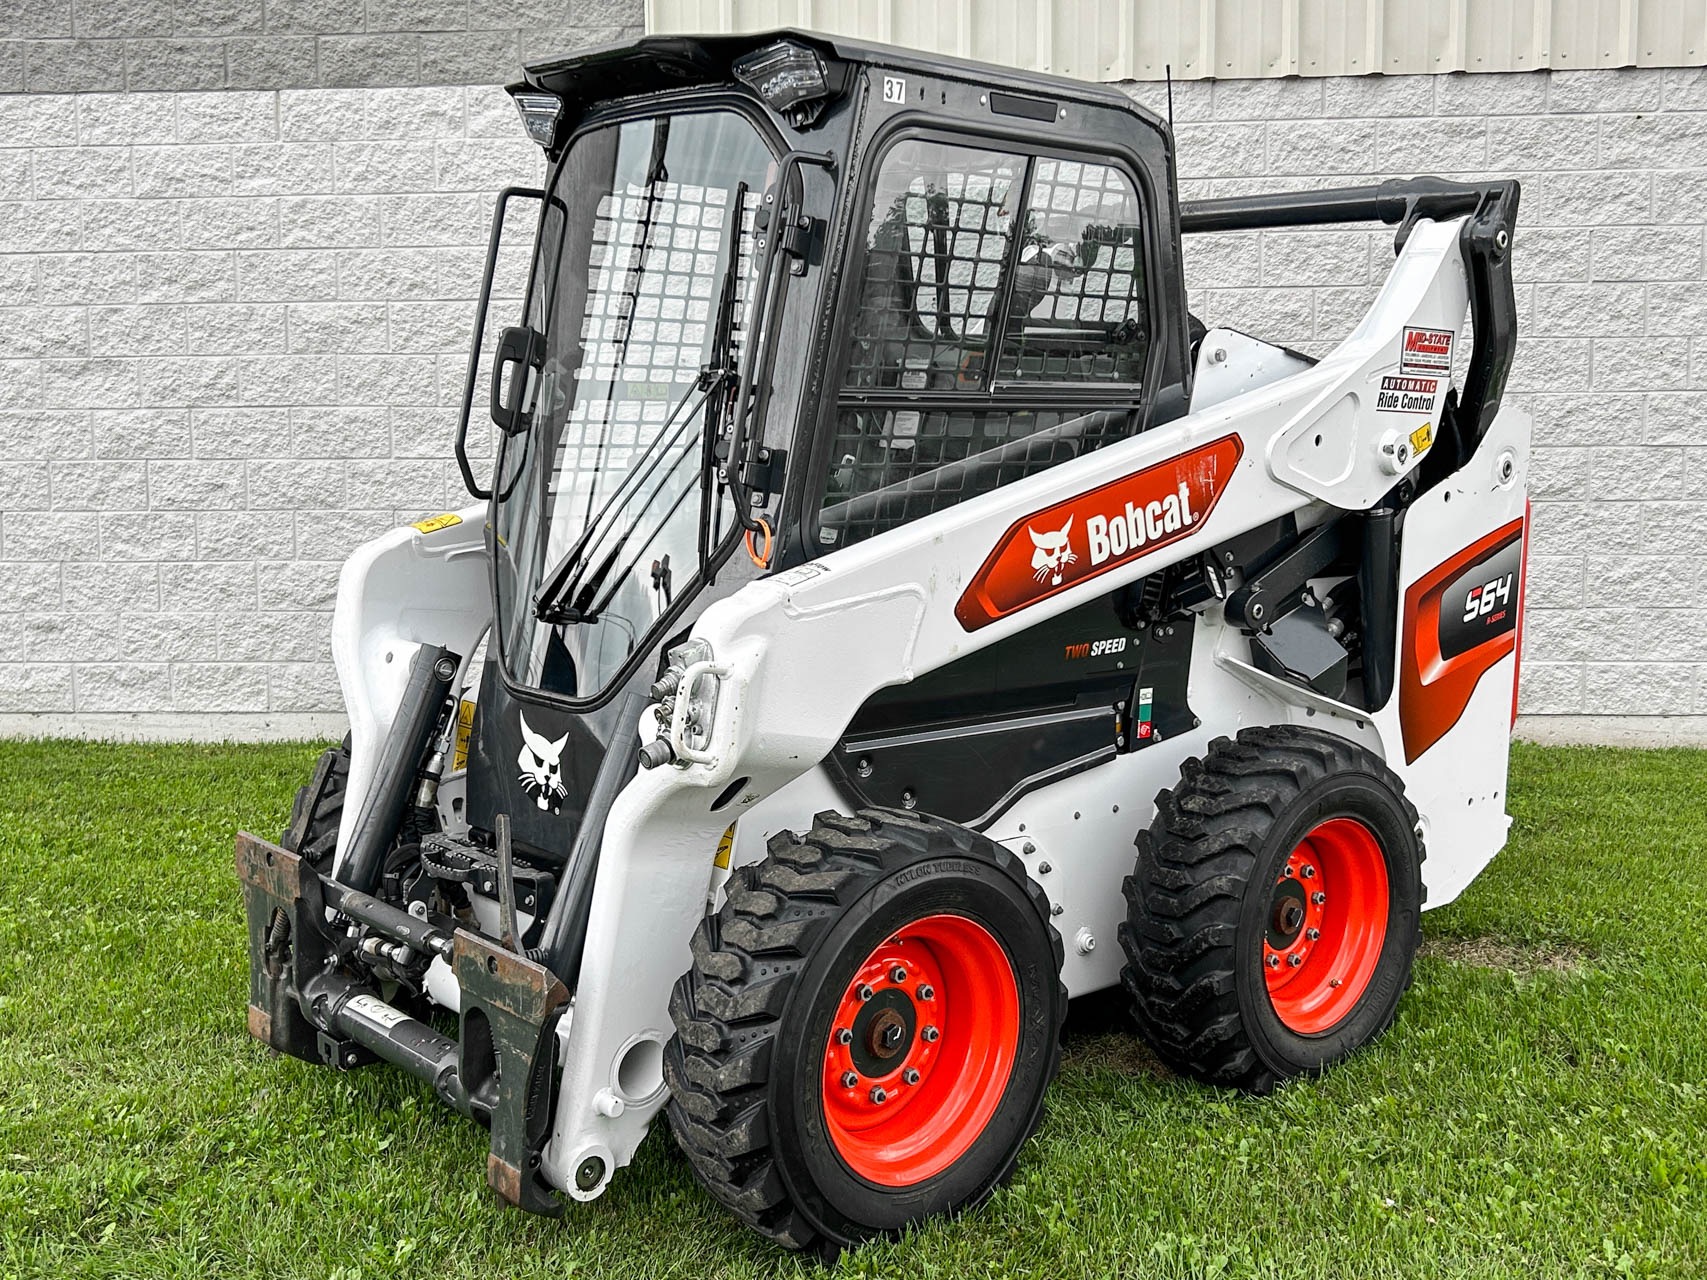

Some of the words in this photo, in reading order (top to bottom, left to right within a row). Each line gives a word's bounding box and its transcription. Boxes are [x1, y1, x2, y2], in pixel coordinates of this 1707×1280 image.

[885, 79, 904, 101] 37
[1382, 378, 1437, 393] AUTOMATIC
[1376, 391, 1400, 409] Ride
[1400, 392, 1436, 411] Control
[1086, 481, 1193, 567] Bobcat
[1463, 572, 1513, 623] S64
[1064, 643, 1090, 661] TWO
[1090, 637, 1127, 657] SPEED
[895, 863, 932, 887] NYLON
